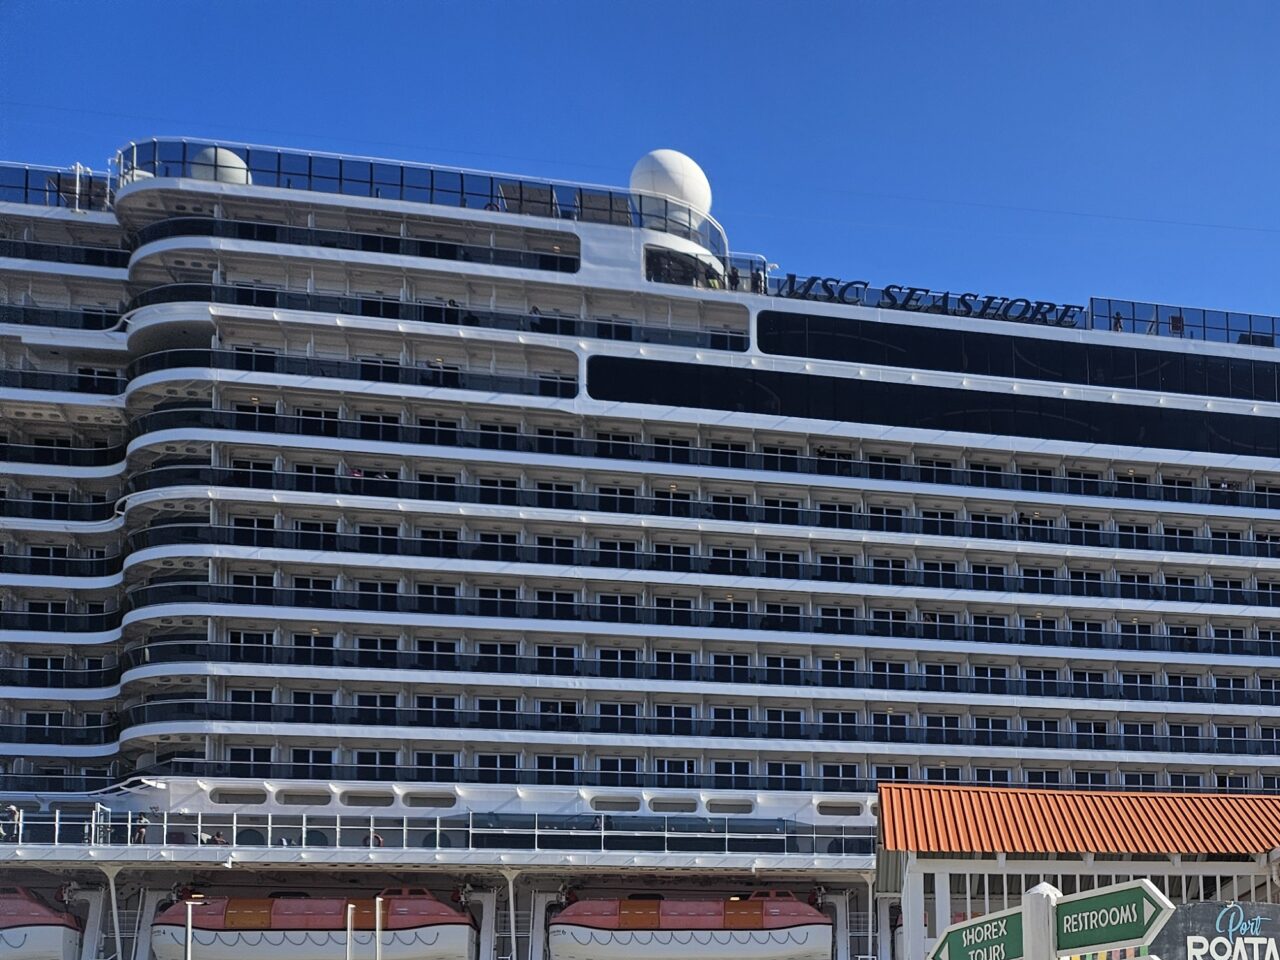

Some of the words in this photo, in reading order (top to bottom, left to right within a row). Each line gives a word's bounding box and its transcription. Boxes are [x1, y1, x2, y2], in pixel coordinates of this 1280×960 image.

[777, 273, 870, 306] MSC
[877, 285, 1085, 328] SEASHORE
[963, 919, 1007, 947] SHOREX
[1064, 904, 1138, 933] RESTROOMS
[1215, 904, 1272, 944] Port
